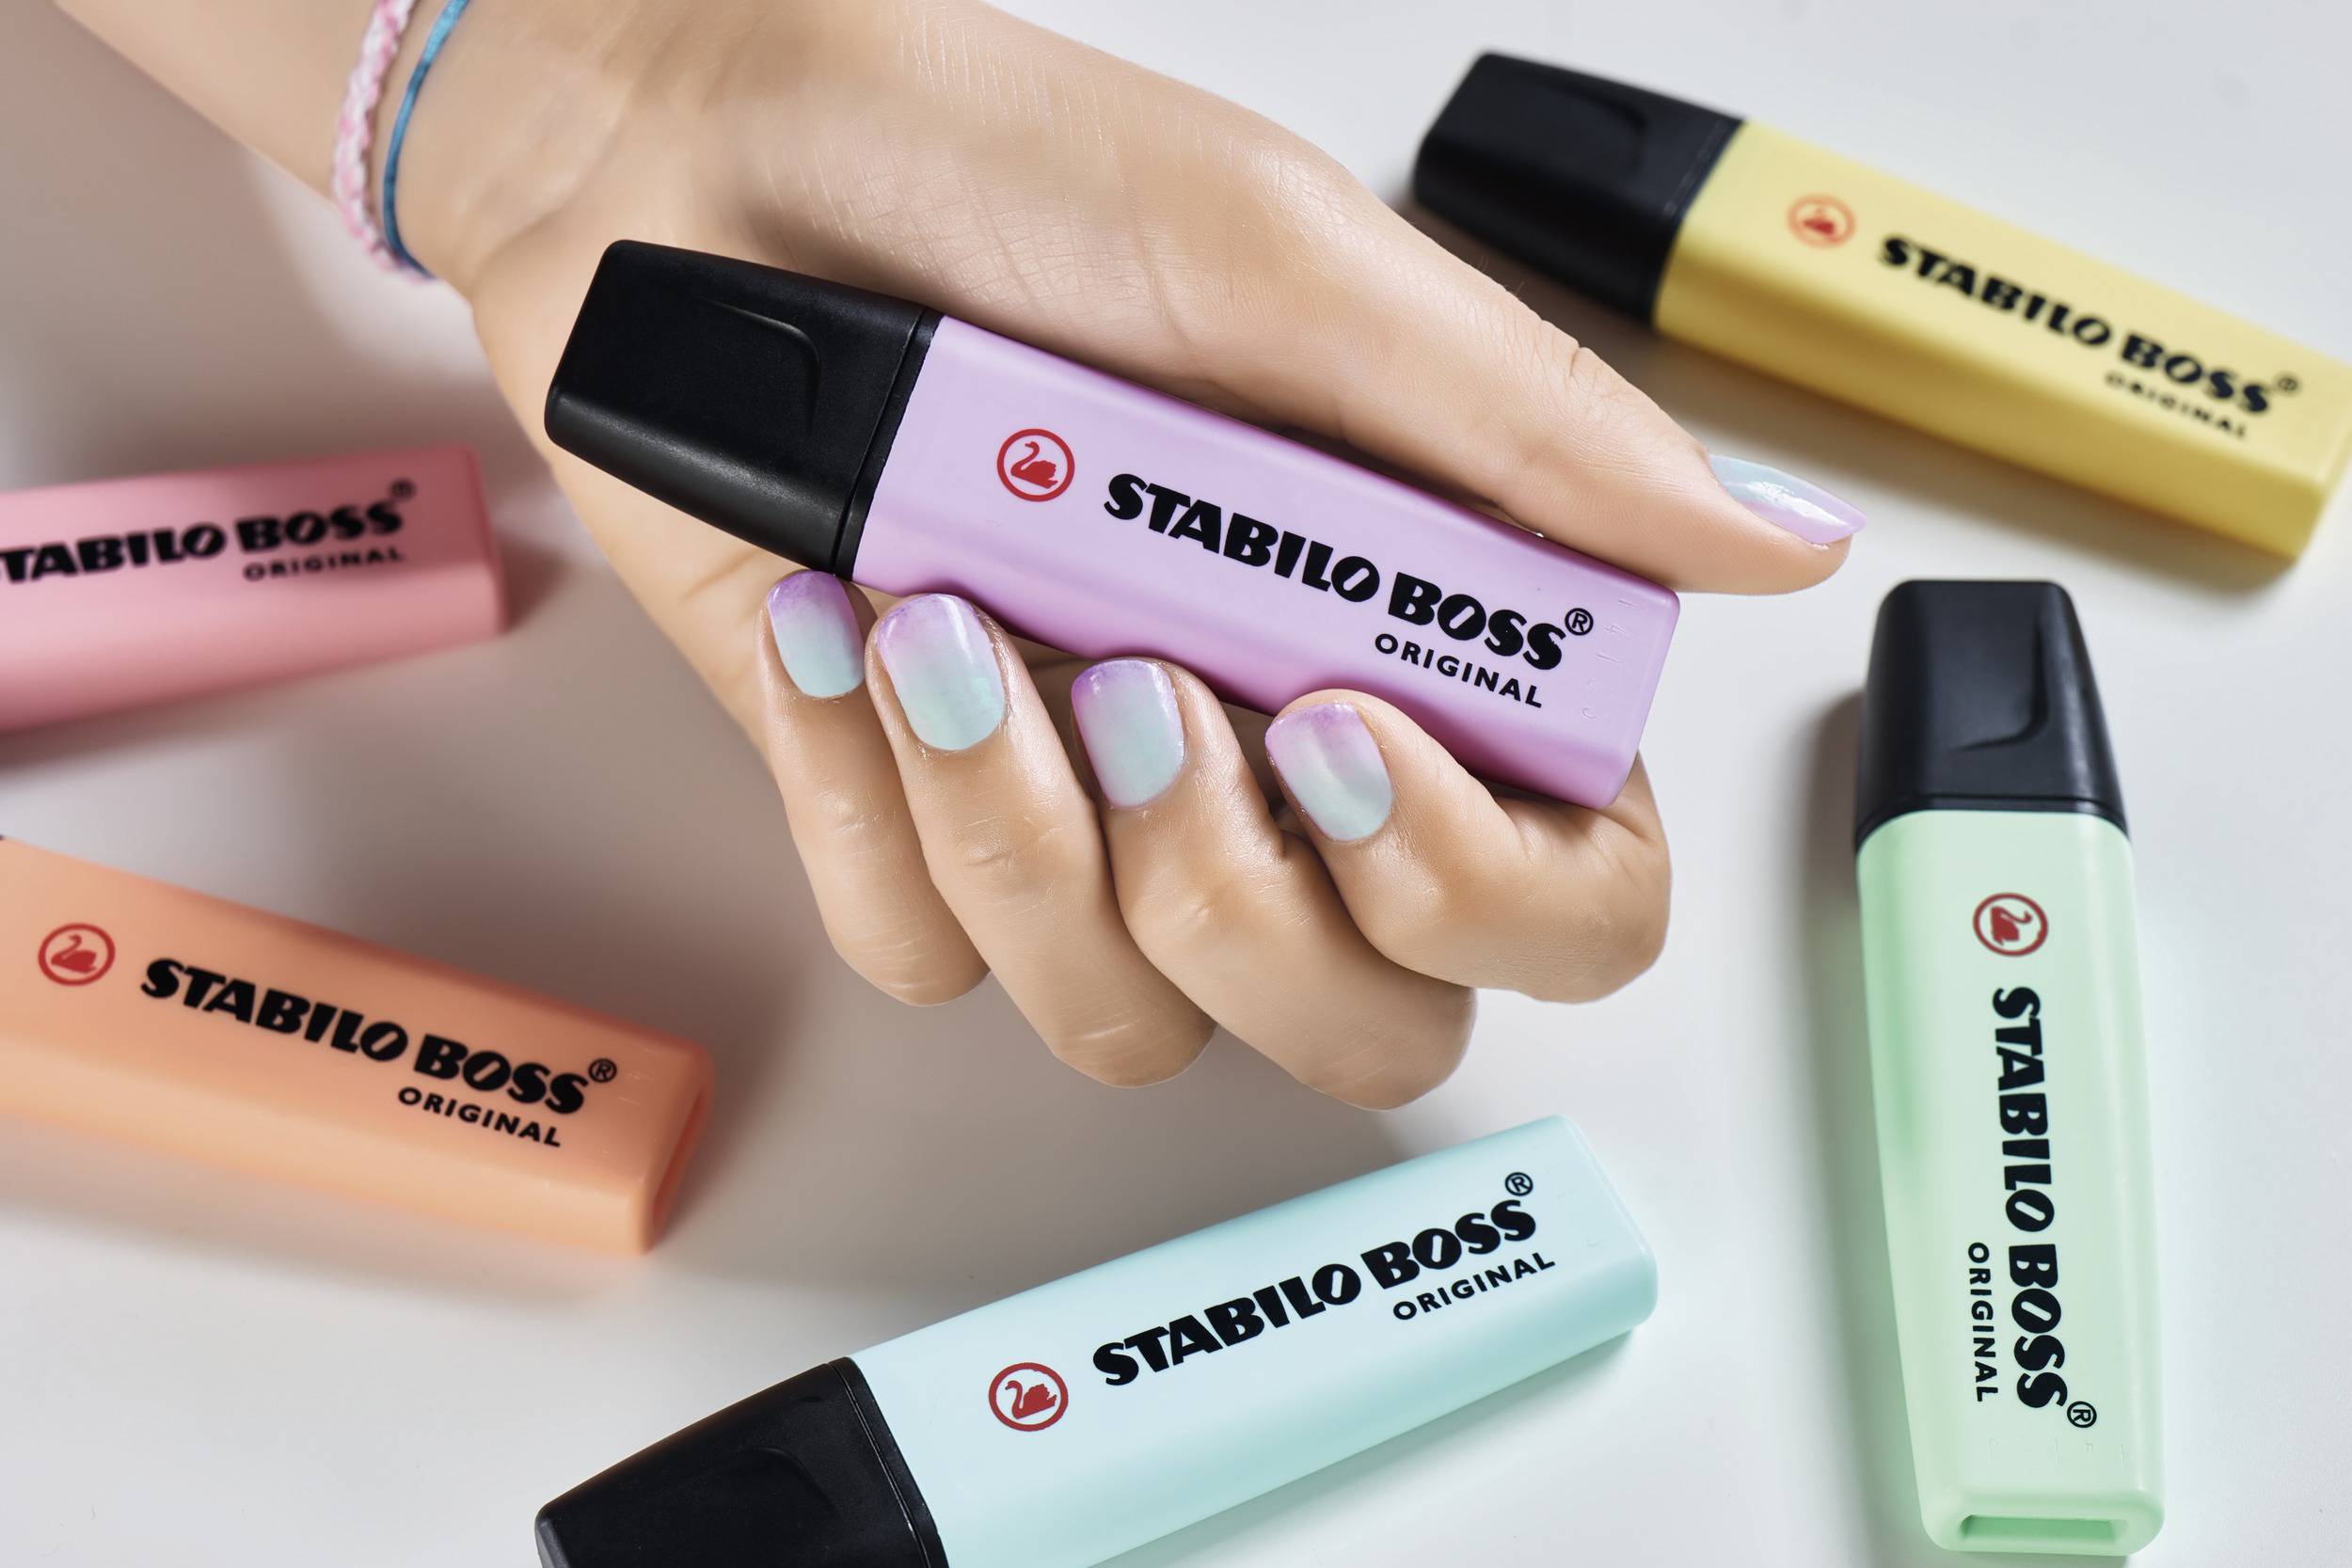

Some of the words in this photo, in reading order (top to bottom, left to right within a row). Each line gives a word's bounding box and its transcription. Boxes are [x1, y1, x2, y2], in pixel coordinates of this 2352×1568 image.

[1882, 234, 2113, 348] STABILO
[2105, 370, 2248, 440] ORIGINAL
[0, 524, 227, 583] TABILO
[244, 547, 404, 580] ORIGINAL
[1104, 473, 1380, 603] STABILO
[1375, 633, 1542, 708] ORIGINAL
[140, 958, 409, 1062] STABILO
[397, 1086, 562, 1148] ORIGINAL
[1992, 987, 2055, 1233] STABILO
[1092, 1263, 1362, 1386] STABILO
[1392, 1252, 1556, 1321] ORIGINAL
[1967, 1242, 1999, 1402] ORIGINAL
